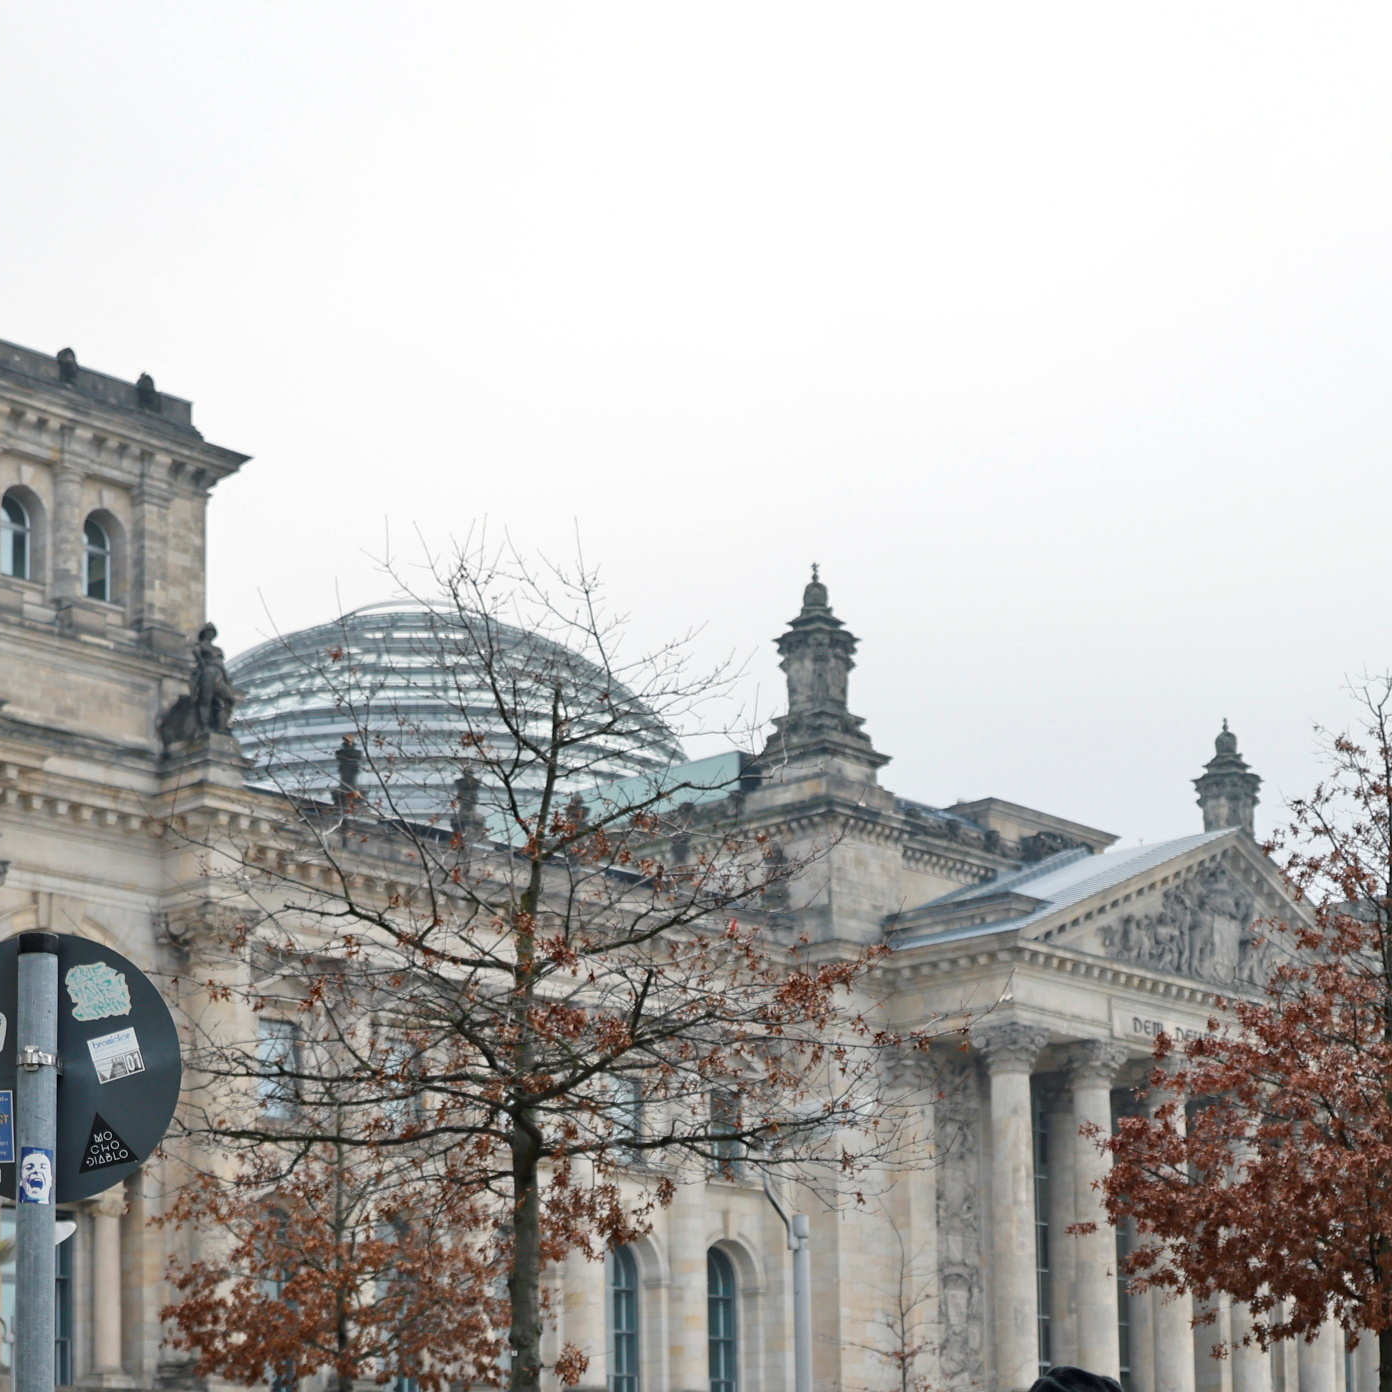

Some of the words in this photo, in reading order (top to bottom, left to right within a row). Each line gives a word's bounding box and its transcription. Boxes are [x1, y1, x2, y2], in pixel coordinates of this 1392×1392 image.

[1133, 1017, 1164, 1037] DEM
[127, 1053, 142, 1071] 01
[94, 1131, 113, 1143] MO
[90, 1140, 120, 1155] CHO
[86, 1149, 129, 1167] DIABLO
